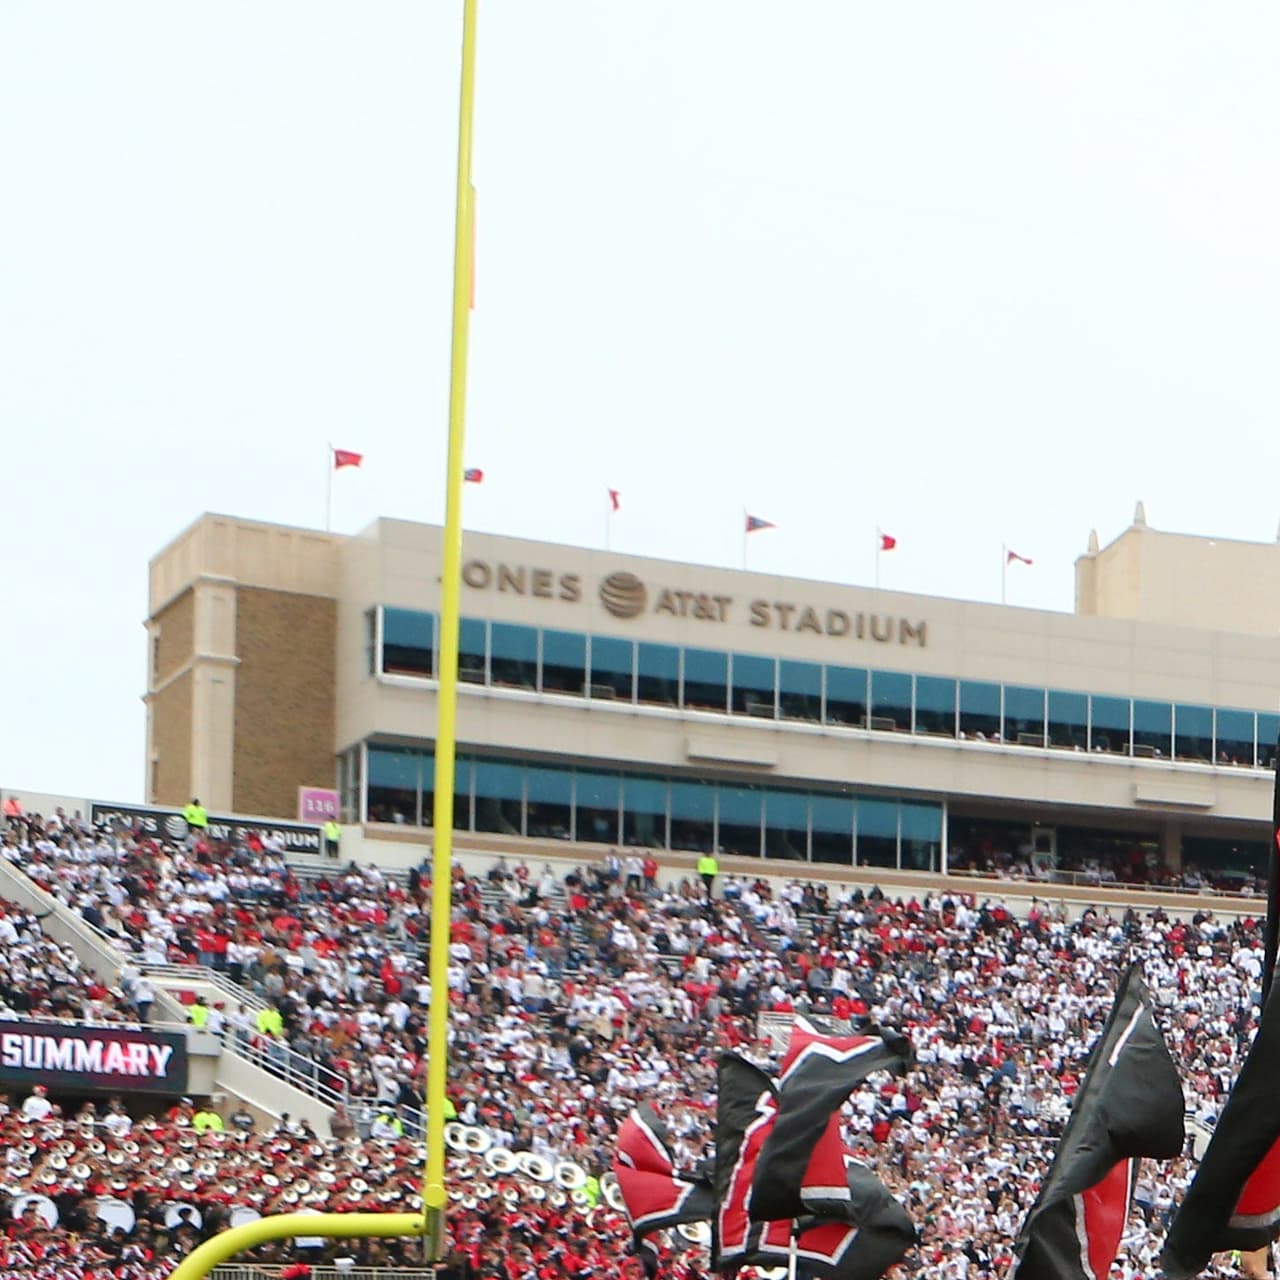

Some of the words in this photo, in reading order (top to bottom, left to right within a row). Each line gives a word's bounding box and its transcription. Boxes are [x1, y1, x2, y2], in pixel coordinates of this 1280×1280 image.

[437, 559, 582, 602] ONES
[654, 587, 733, 622] AT&T
[749, 599, 928, 647] STADIUM
[1, 1033, 173, 1078] SUMMARY
